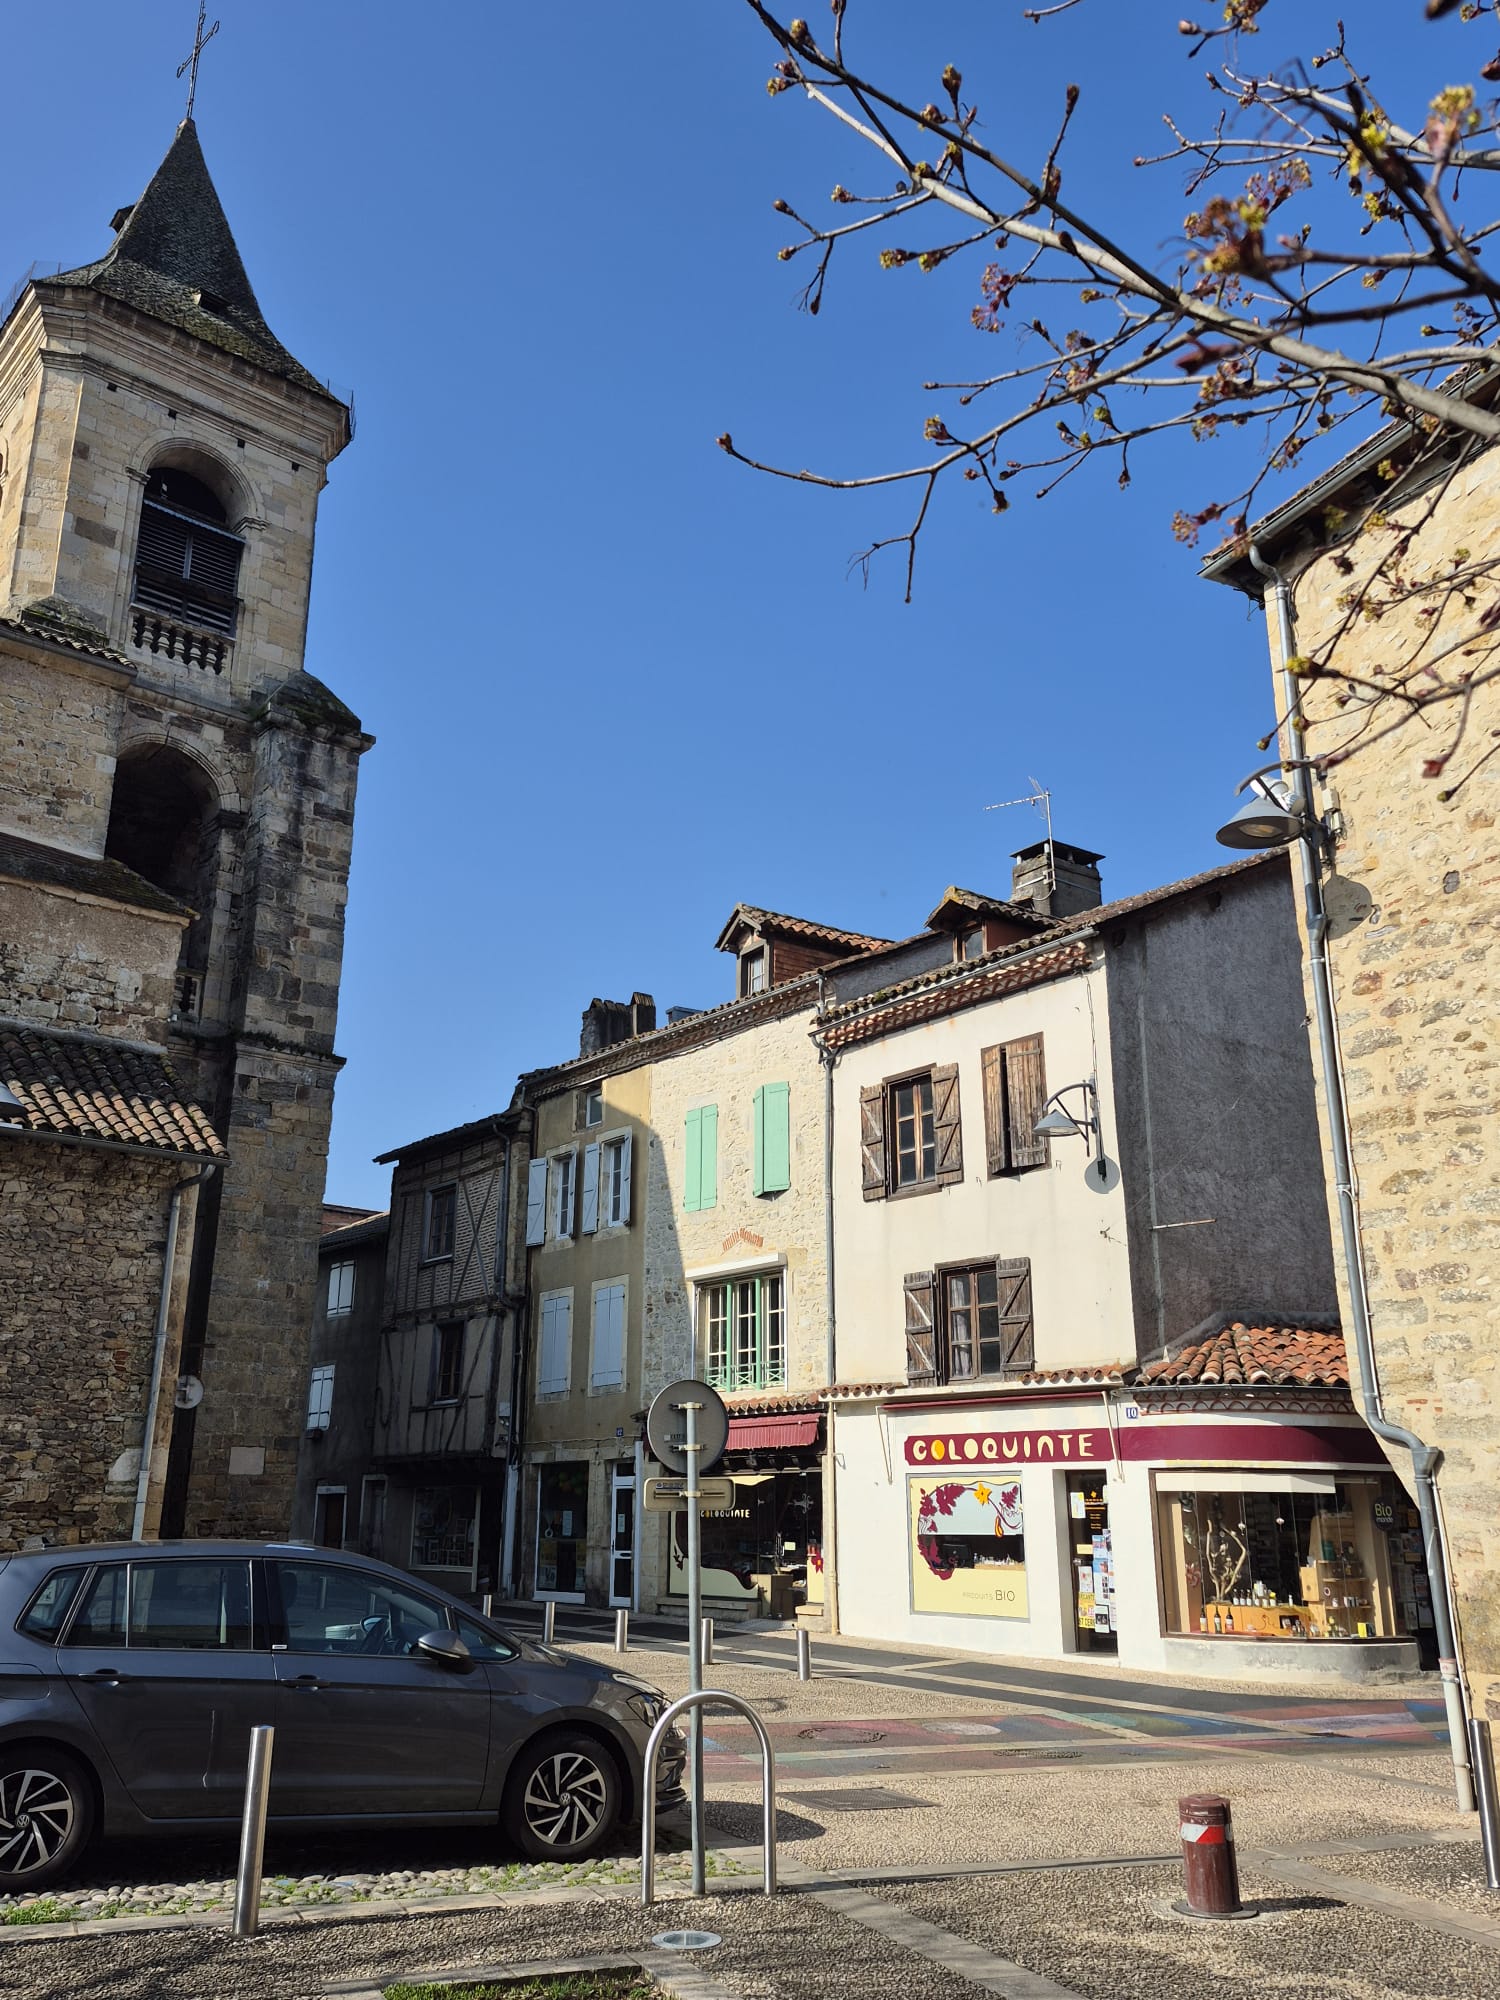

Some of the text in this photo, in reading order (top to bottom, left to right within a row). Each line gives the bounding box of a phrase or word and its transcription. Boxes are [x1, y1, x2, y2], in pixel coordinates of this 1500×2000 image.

[1127, 1407, 1137, 1418] 10
[912, 1434, 1095, 1461] COLOQUINTE
[700, 1509, 750, 1518] COLOQUINTE
[1374, 1501, 1392, 1517] Bio
[995, 1589, 1016, 1601] BIO
